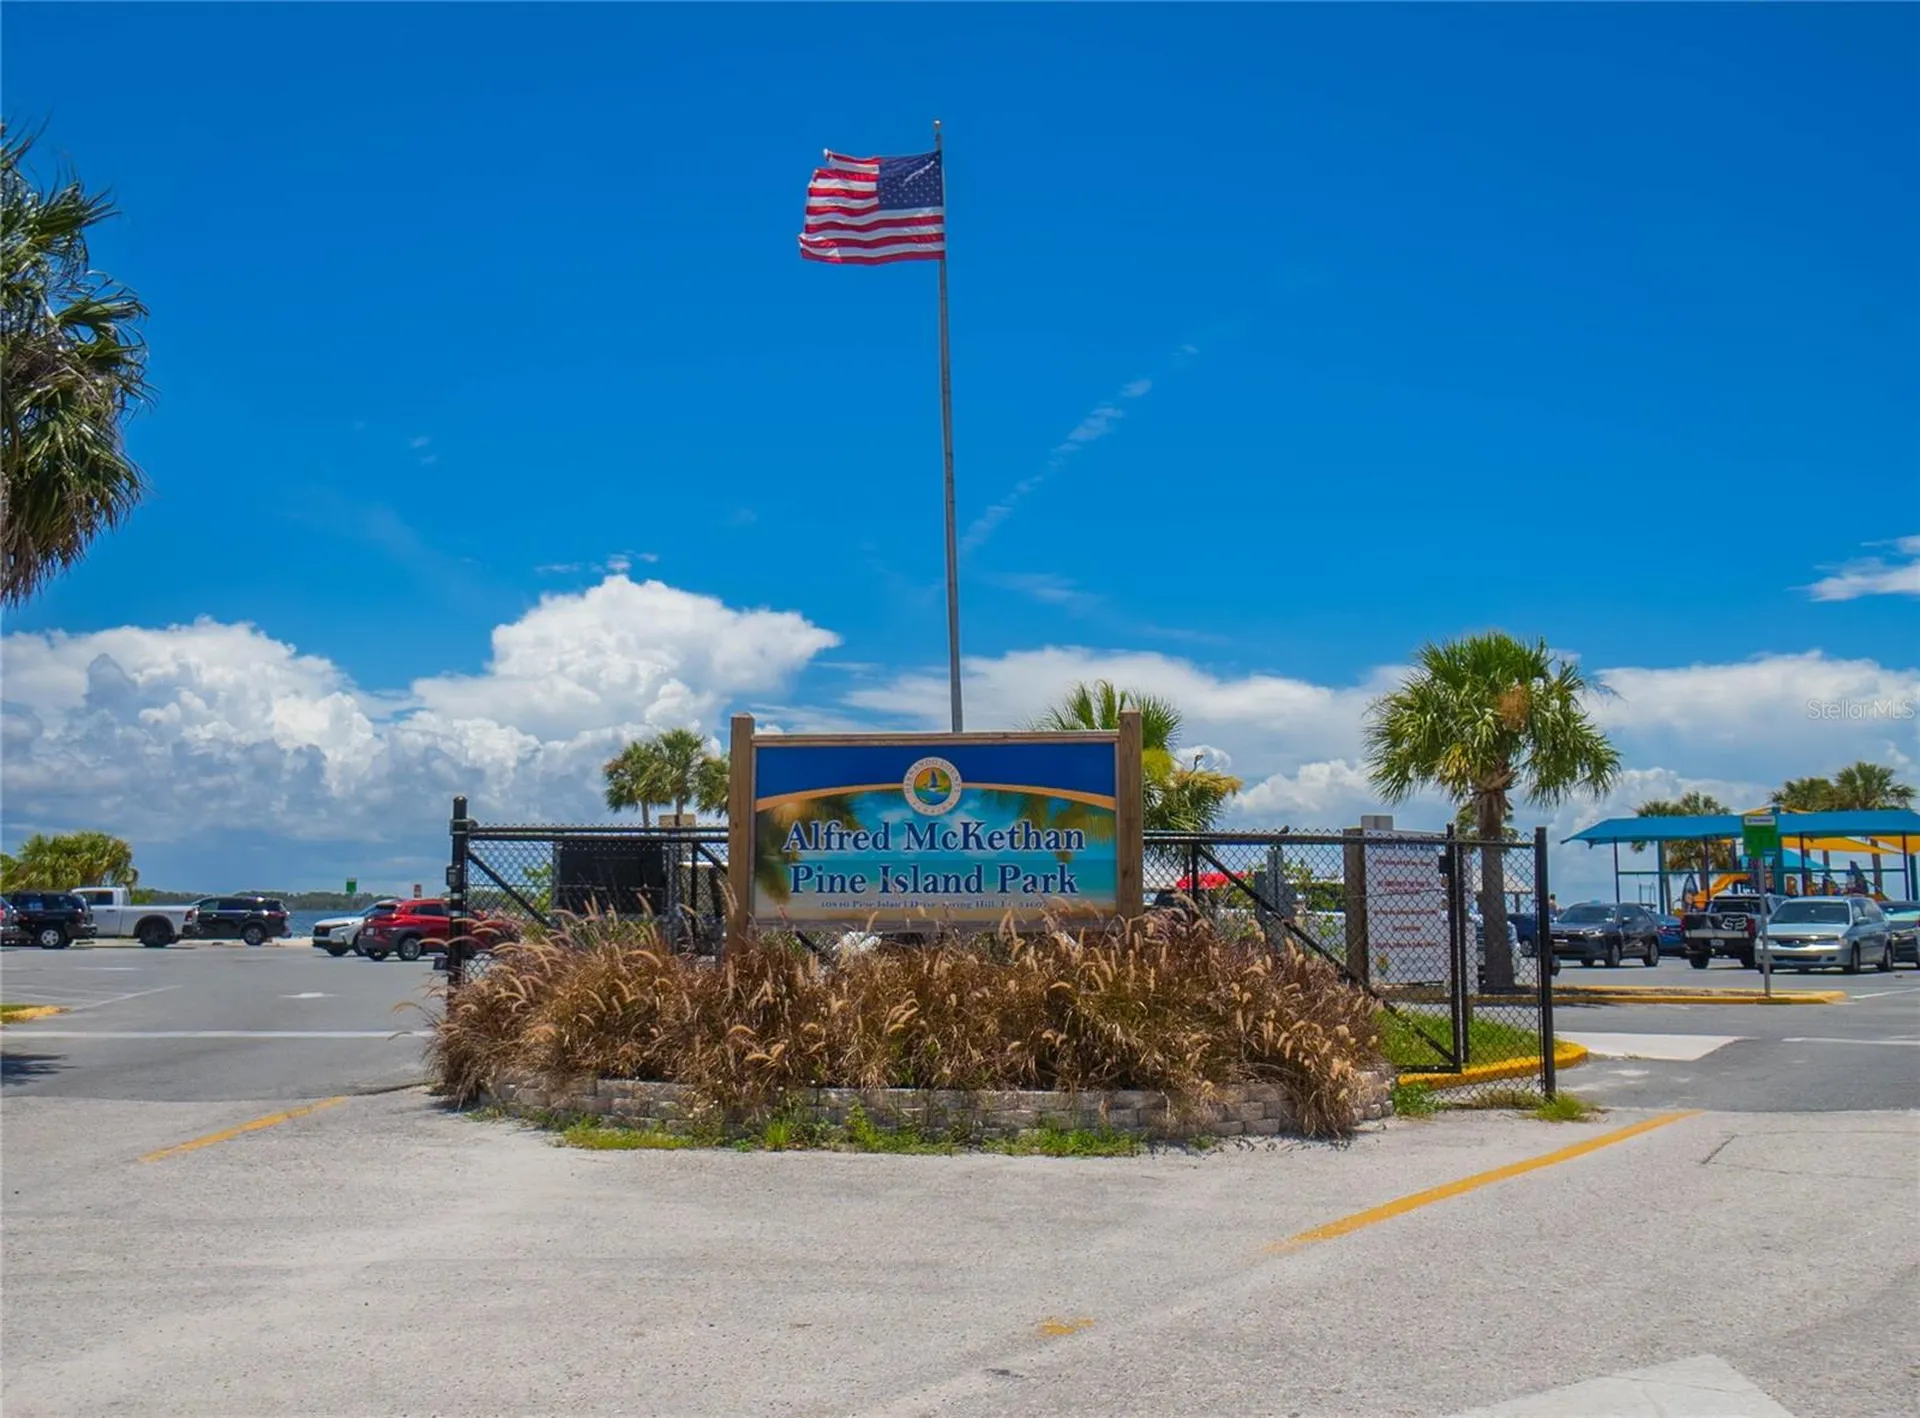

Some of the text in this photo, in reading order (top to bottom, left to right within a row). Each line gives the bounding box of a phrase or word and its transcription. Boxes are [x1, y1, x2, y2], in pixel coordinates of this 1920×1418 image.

[783, 820, 1085, 851] Alfred McKethan
[790, 863, 1079, 894] Pine Island Park
